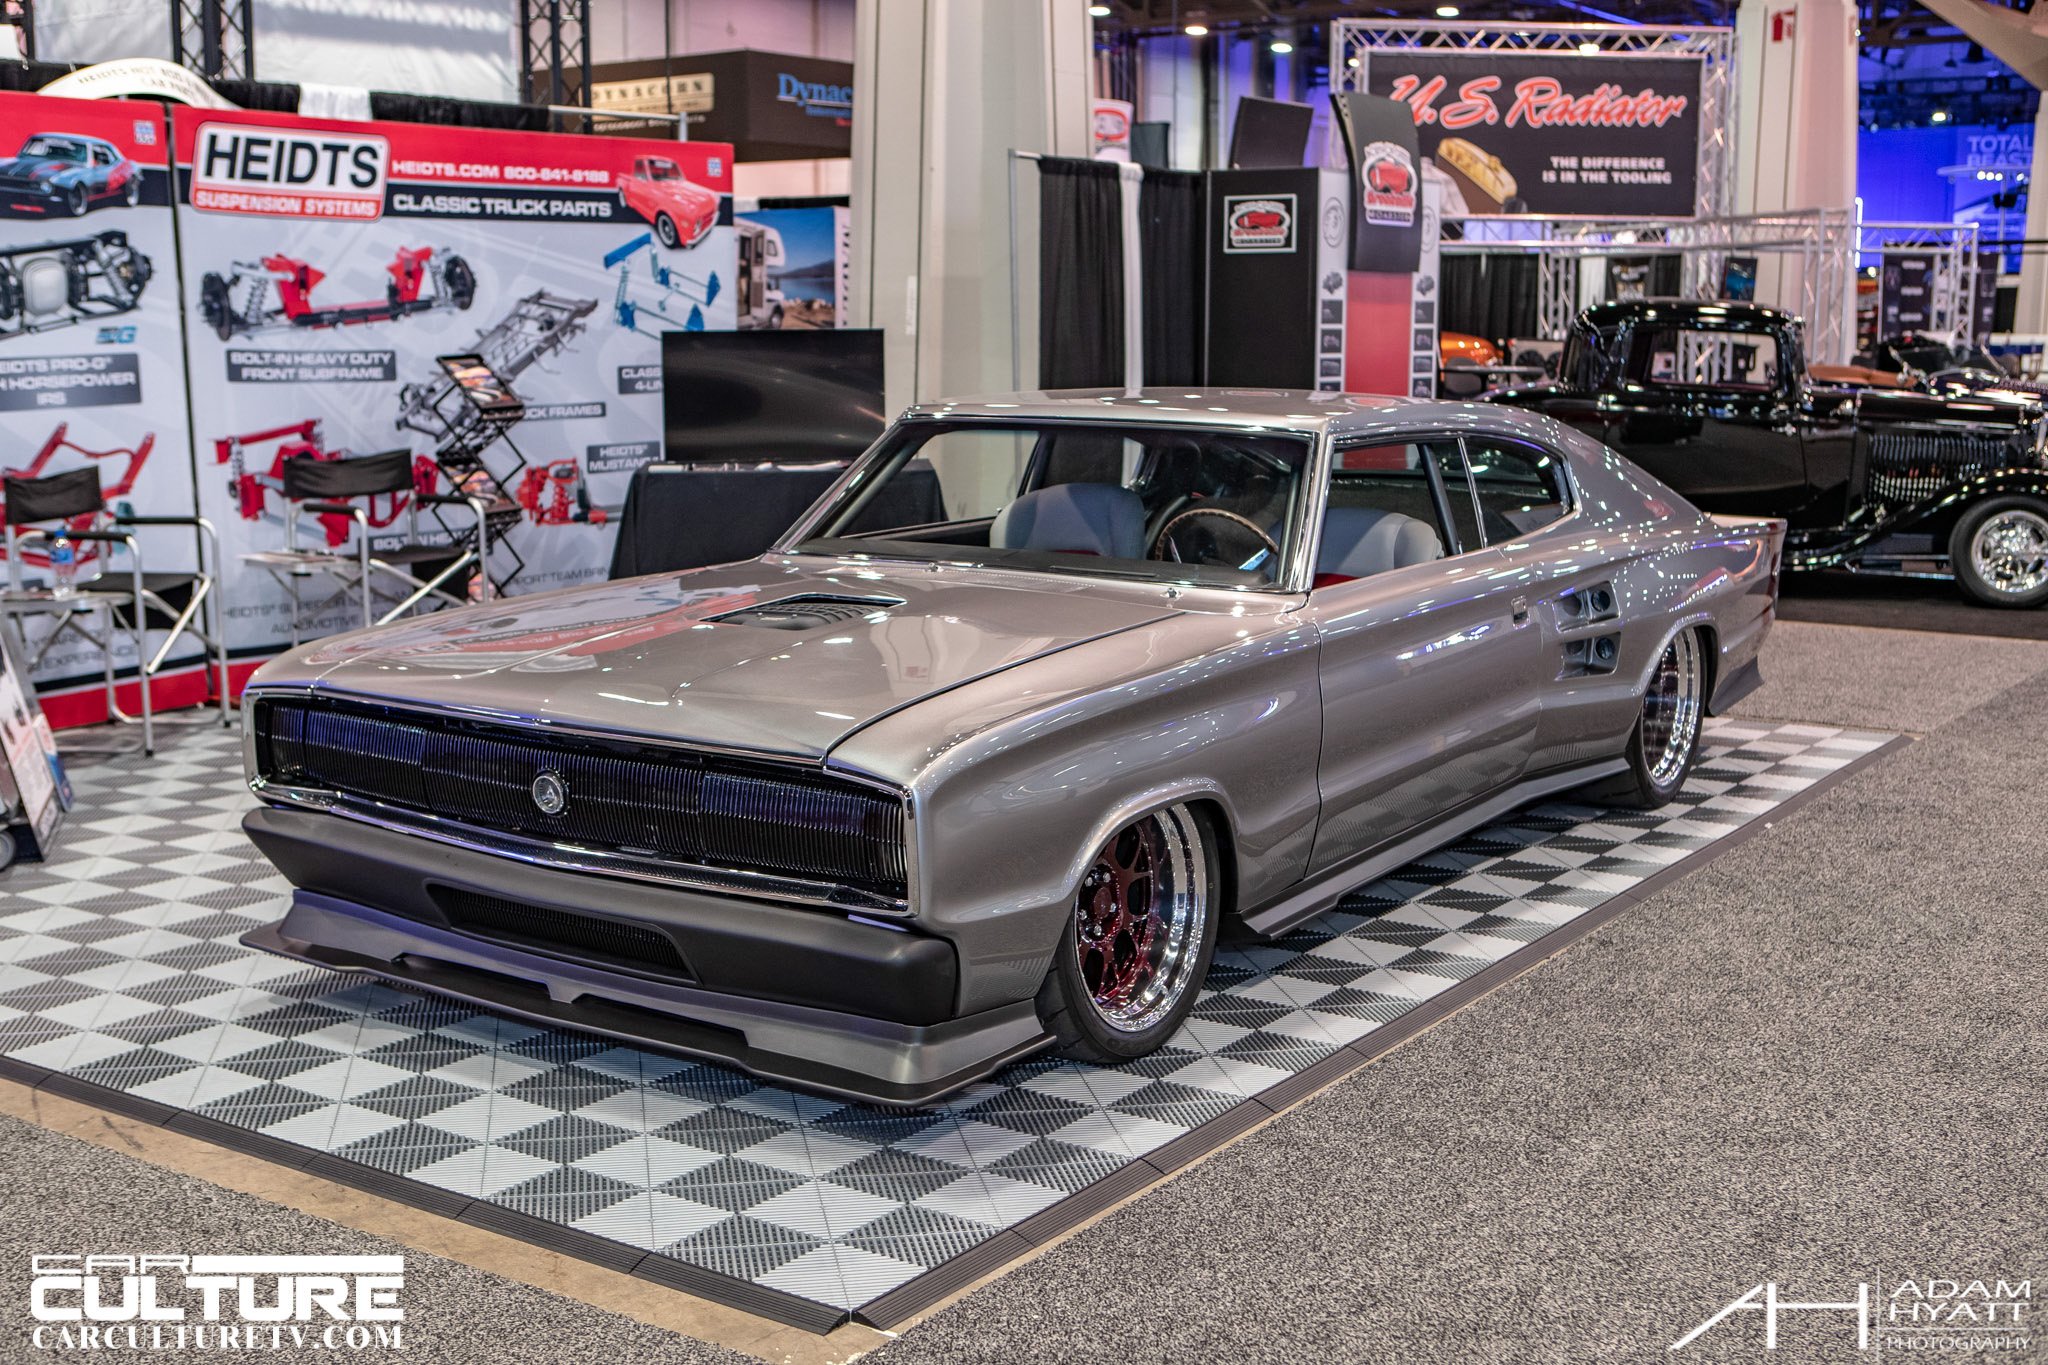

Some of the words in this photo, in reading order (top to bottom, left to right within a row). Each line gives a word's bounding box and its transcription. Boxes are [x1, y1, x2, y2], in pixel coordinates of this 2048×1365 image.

[777, 73, 853, 107] Dynac
[1505, 76, 1687, 128] Radiator
[1967, 134, 2033, 153] TOTAL
[204, 134, 379, 188] HEIDTS
[392, 160, 499, 178] HEIDTS.COM
[1550, 156, 1579, 169] THE
[1581, 156, 1665, 170] DIFFERENCE
[1542, 170, 1557, 183] IS
[1560, 170, 1577, 183] IN
[1580, 171, 1608, 184] THE
[1611, 171, 1672, 184] TOOLING
[196, 191, 300, 213] SUSPENSION
[304, 199, 376, 217] SYSTEMS
[393, 193, 481, 213] CLASSIC
[482, 198, 548, 215] TRUCK
[549, 200, 612, 217] PARTS
[230, 352, 292, 365] BOLT-IN
[294, 352, 348, 365] HEAVY
[349, 352, 392, 365] DUTY
[8, 372, 136, 391] HORSEPOWER
[241, 367, 295, 380] FRONT
[298, 367, 384, 380] SUBFRAME
[622, 368, 661, 379] CLASS
[548, 404, 602, 417] FRAMES
